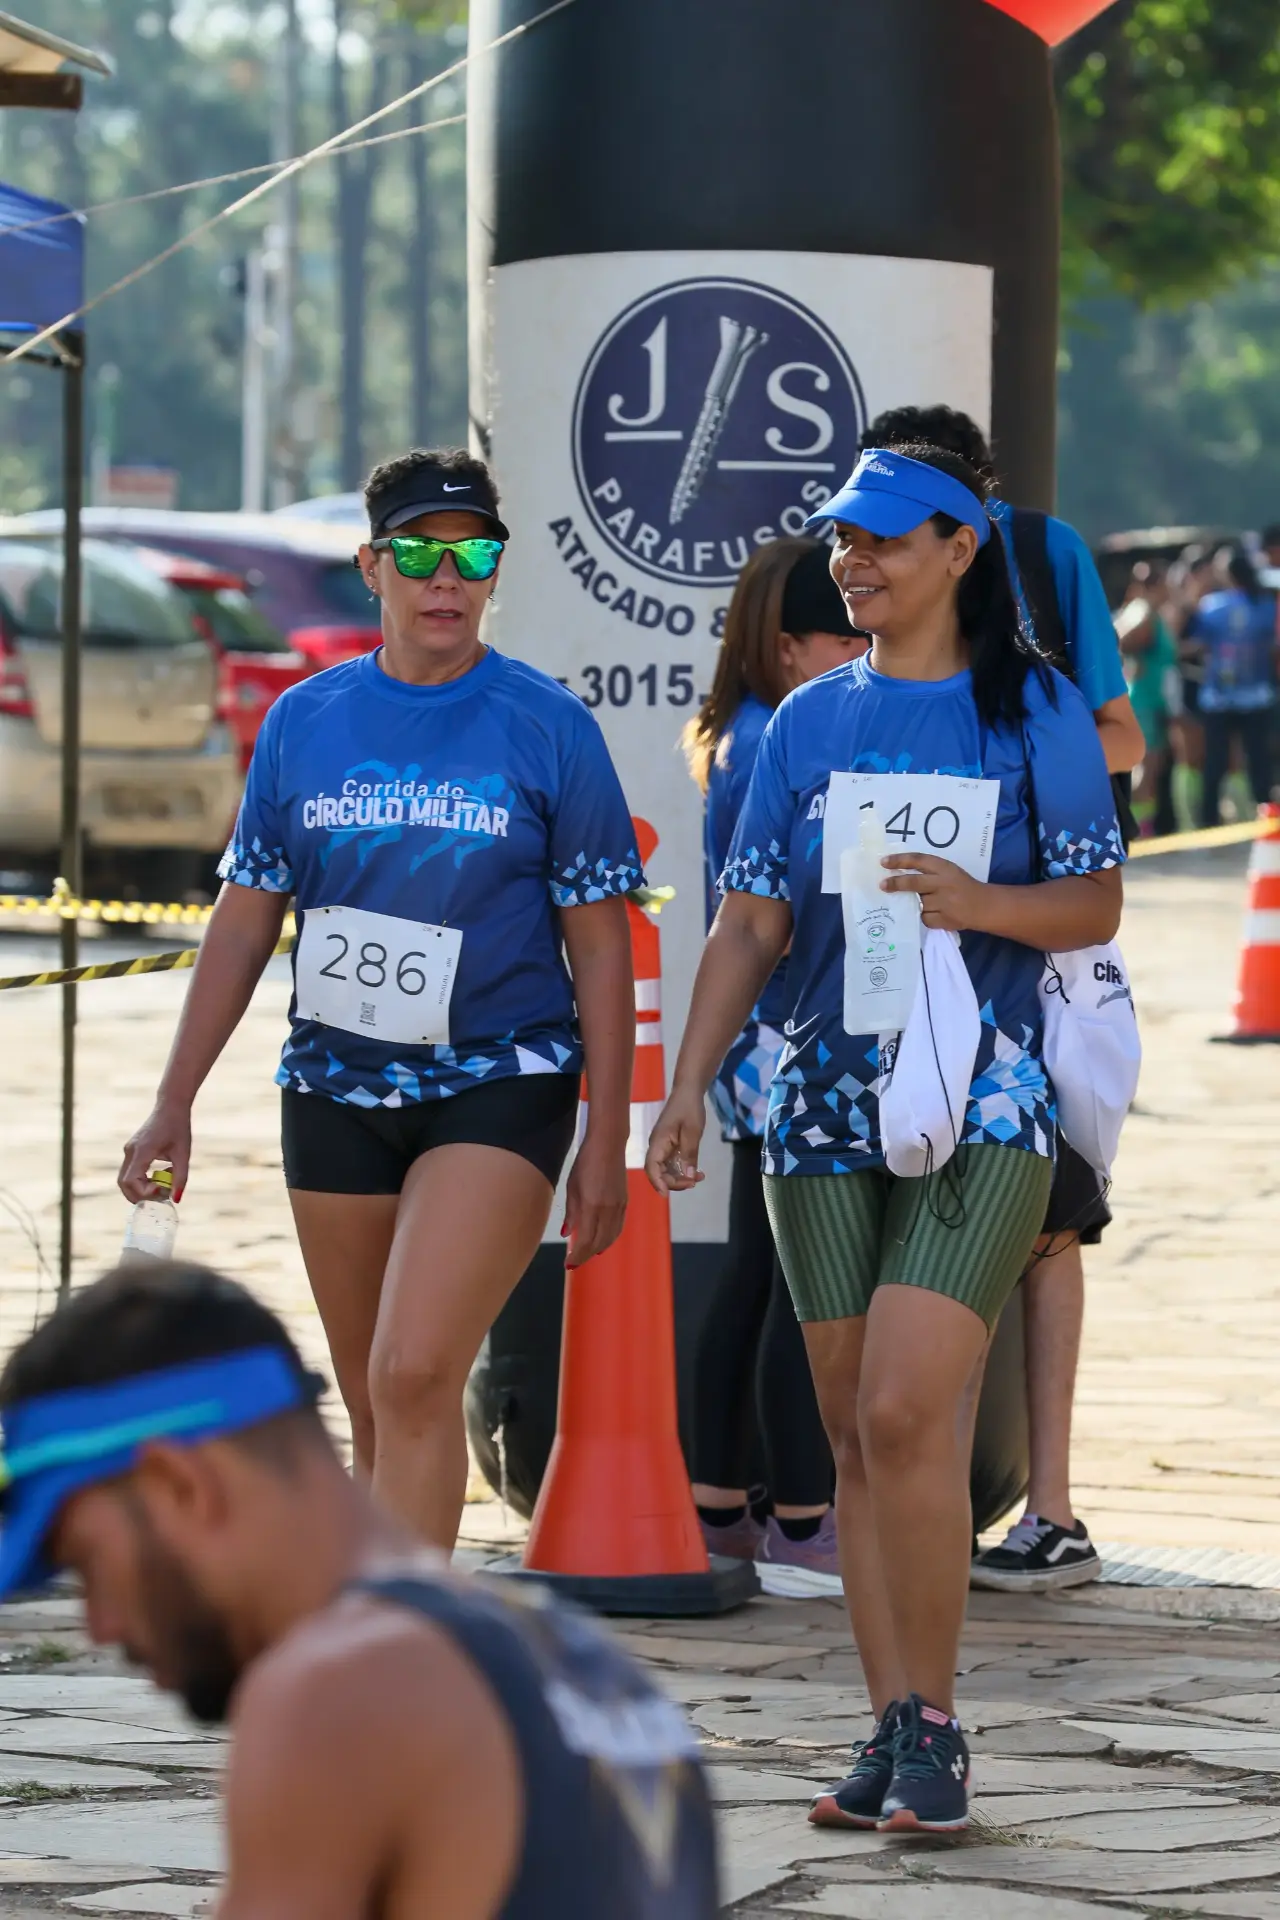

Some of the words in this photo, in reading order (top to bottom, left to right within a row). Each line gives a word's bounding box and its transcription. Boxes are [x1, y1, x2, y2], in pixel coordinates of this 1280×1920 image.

[548, 516, 695, 636] ATACADO
[342, 779, 429, 798] Corrida
[436, 781, 465, 800] do
[303, 792, 404, 829] CÍRCULO
[408, 797, 510, 837] MILITAR
[859, 801, 960, 849] 40
[319, 933, 427, 996] 286
